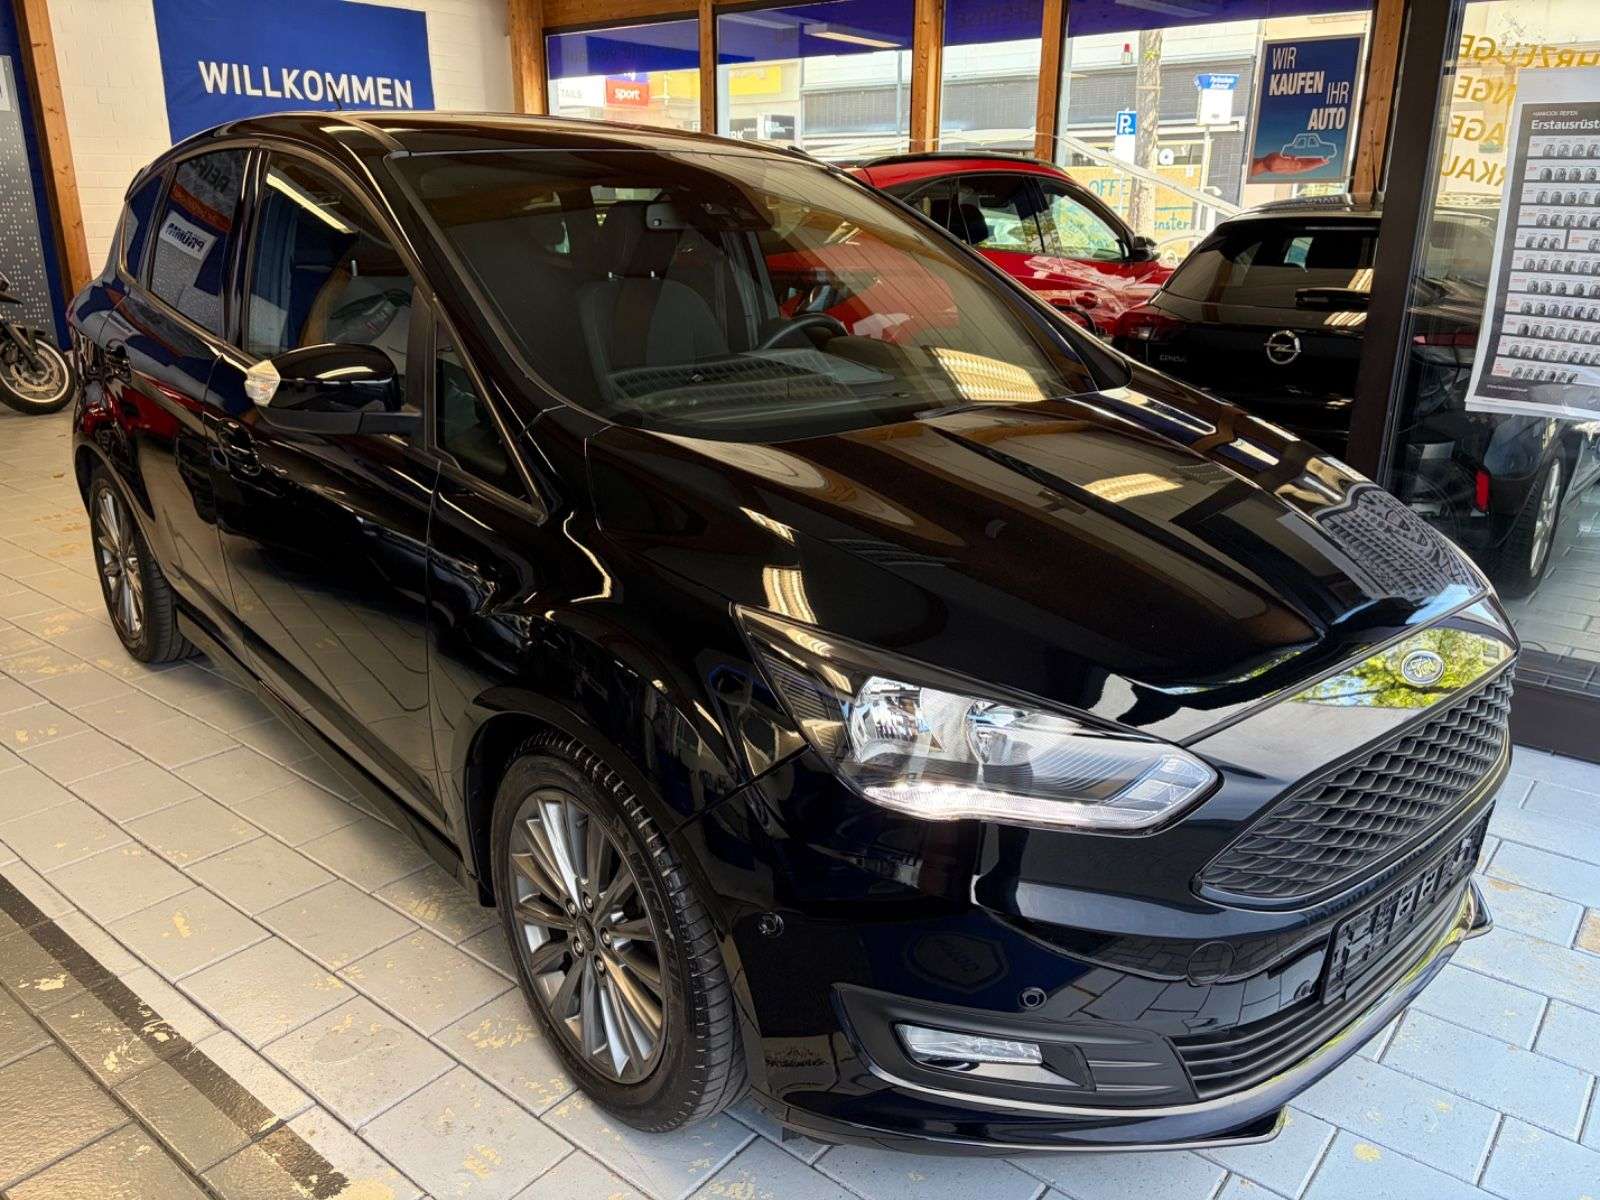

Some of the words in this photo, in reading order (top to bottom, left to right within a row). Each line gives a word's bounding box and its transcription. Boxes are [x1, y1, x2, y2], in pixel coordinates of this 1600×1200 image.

[1272, 47, 1297, 71] WIR
[198, 61, 414, 109] WILLKOMMEN
[614, 87, 641, 102] sport
[1269, 71, 1326, 97] KAUFEN
[1326, 81, 1350, 105] IHR
[1119, 114, 1132, 133] P
[1307, 107, 1347, 131] AUTO
[1531, 118, 1600, 130] Erstausrüst
